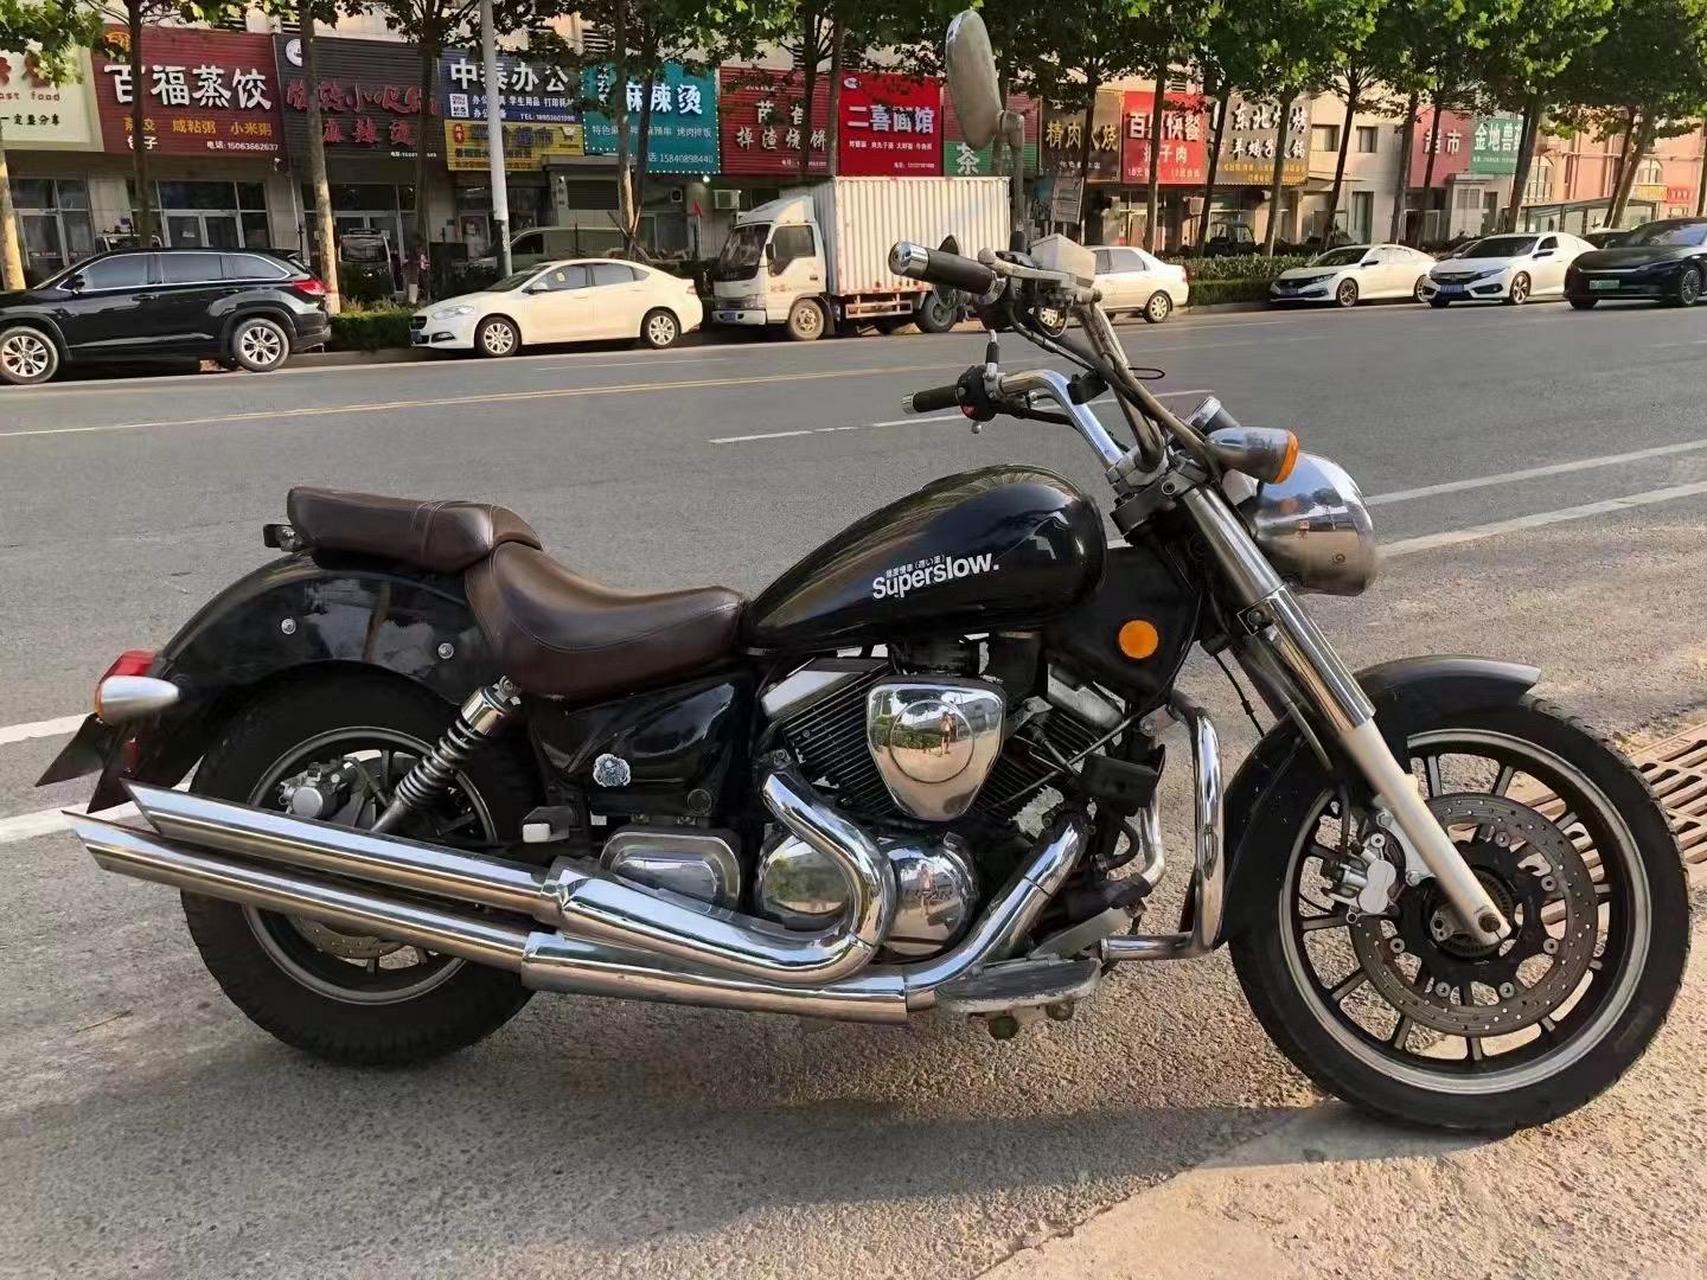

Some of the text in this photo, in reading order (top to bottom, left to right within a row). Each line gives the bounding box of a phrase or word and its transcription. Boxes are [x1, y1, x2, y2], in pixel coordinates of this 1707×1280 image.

[31, 90, 60, 101] food
[104, 64, 272, 110] 百福蒸饺
[230, 122, 272, 137] 小米粥
[956, 141, 980, 175] 茶
[871, 552, 1000, 600] Superslow.
